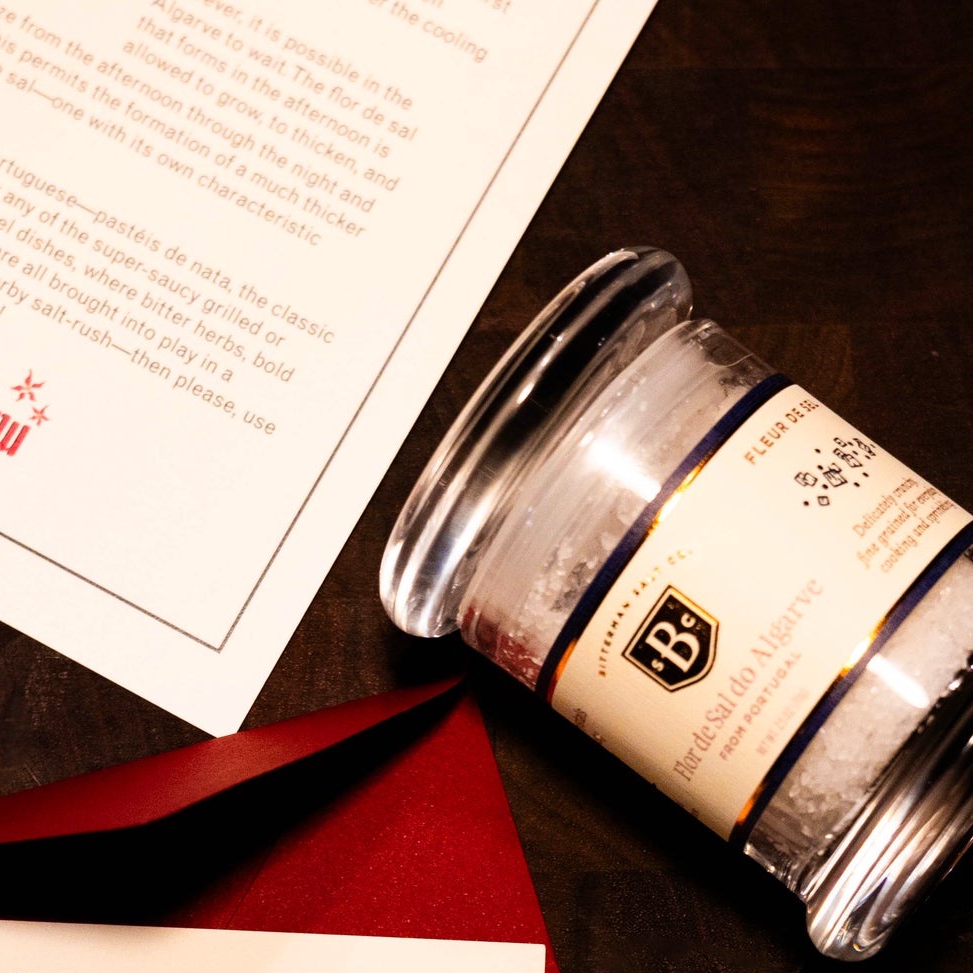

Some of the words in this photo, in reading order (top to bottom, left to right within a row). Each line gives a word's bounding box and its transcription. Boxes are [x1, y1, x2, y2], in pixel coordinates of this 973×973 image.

[17, 49, 88, 92] permits
[91, 86, 121, 109] the
[124, 99, 210, 157] formation
[214, 153, 236, 169] of
[235, 164, 247, 177] a
[250, 172, 299, 204] much
[302, 196, 365, 236] thicker
[20, 15, 61, 48] from
[64, 40, 93, 65] the
[96, 60, 183, 113] afternoon
[187, 105, 254, 151] through
[258, 144, 287, 167] the
[291, 163, 337, 194] night
[339, 189, 376, 212] and
[89, 115, 125, 142] with
[130, 135, 153, 156] its
[156, 152, 193, 178] own
[197, 175, 321, 245] characteristic
[2, 192, 35, 217] any
[38, 210, 60, 226] of
[58, 218, 89, 243] the
[92, 239, 200, 305] super-saucy
[201, 299, 264, 335] grilled
[265, 331, 286, 346] or
[15, 227, 75, 271] dishes,
[83, 265, 137, 299] where
[139, 291, 191, 327] bitter
[193, 320, 245, 362] herbs,
[251, 350, 295, 382] bold
[21, 262, 48, 281] all
[48, 272, 118, 321] brought
[119, 312, 155, 340] into
[157, 336, 198, 364] play
[199, 353, 218, 373] in
[221, 369, 233, 382] a
[164, 246, 187, 265] de
[189, 261, 231, 293] nata,
[238, 284, 268, 308] the
[271, 304, 334, 342] classic
[171, 374, 235, 417] please,
[243, 411, 275, 434] use
[744, 421, 789, 464] FLEUR
[785, 407, 804, 423] DE
[799, 400, 819, 412] SEL
[853, 495, 896, 537] Delicately
[857, 542, 879, 569] fine
[879, 510, 911, 546] grained
[881, 534, 917, 572] cooking
[912, 518, 930, 536] and
[673, 749, 701, 782] Flor
[691, 726, 716, 752] de
[706, 693, 737, 730] Sal
[729, 667, 756, 697] do
[750, 580, 823, 664] Algarve
[720, 725, 746, 760] FROM
[744, 654, 800, 722] PORTUGAL
